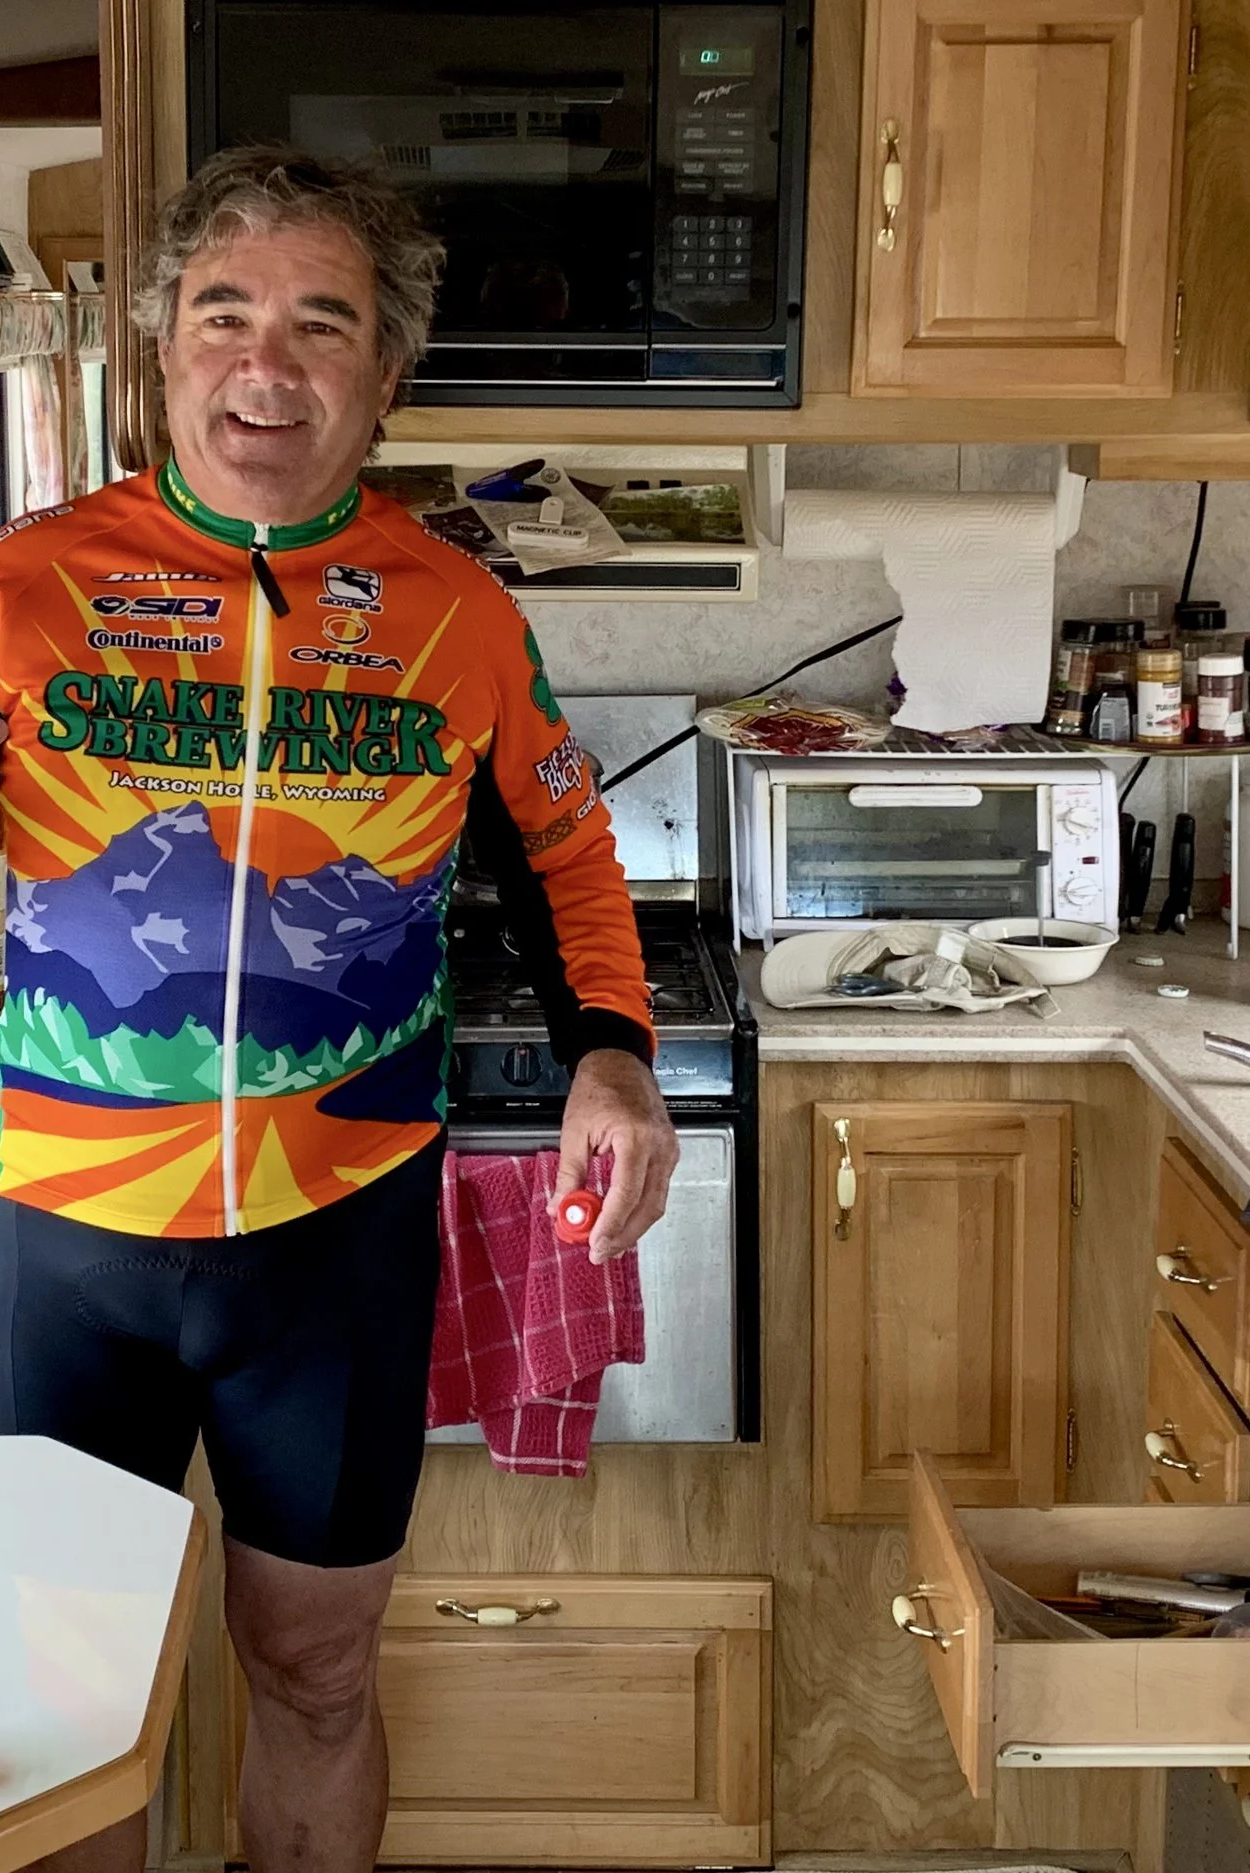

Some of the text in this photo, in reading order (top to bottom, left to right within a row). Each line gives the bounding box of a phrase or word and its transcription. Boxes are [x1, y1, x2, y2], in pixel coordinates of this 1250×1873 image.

[516, 525, 560, 535] MAGNETIC
[86, 628, 210, 655] Continental
[289, 646, 405, 673] ORBEA
[38, 670, 452, 777] SNAKE RIVER
[83, 716, 396, 776] BREWING
[109, 770, 203, 795] JACKSON
[282, 784, 387, 801] WYOMING
